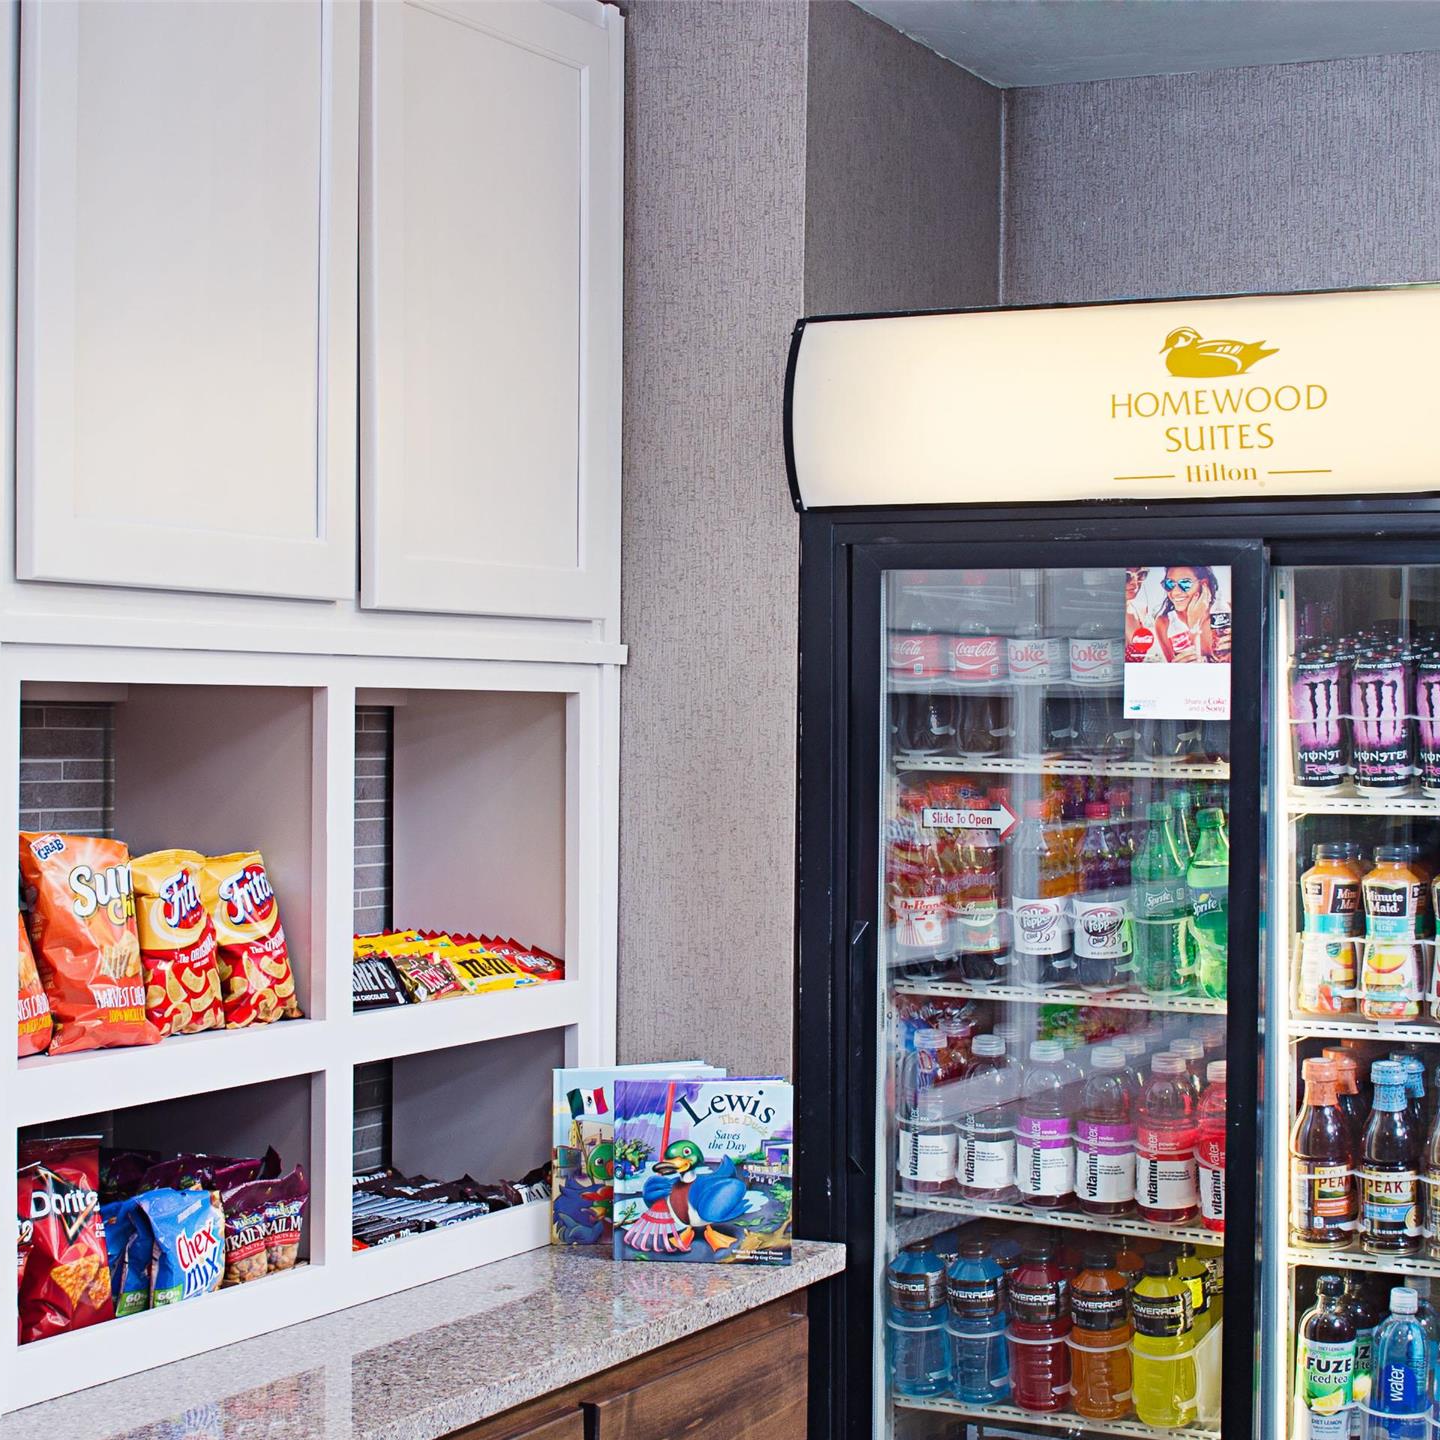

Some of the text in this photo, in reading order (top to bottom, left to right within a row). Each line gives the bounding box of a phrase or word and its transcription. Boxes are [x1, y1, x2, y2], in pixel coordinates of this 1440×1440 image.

[1112, 384, 1328, 419] HOMEWOOD
[1165, 422, 1274, 452] SUITES
[1186, 462, 1257, 482] Hilton
[1009, 646, 1045, 662] Coke
[1071, 645, 1107, 662] Coke
[932, 812, 993, 827] Slide To Open
[38, 838, 64, 860] GRAB
[160, 868, 200, 928] Frit
[218, 868, 275, 926] Frito
[1192, 898, 1218, 915] Sprite
[678, 1090, 775, 1127] Lewis
[715, 1130, 740, 1140] Saves
[719, 1115, 769, 1135] The Duck
[708, 1139, 746, 1153] the Day
[31, 1190, 100, 1219] Dorito
[177, 1222, 214, 1268] Chex
[1307, 1357, 1351, 1374] FUZE
[1389, 1365, 1405, 1402] water
